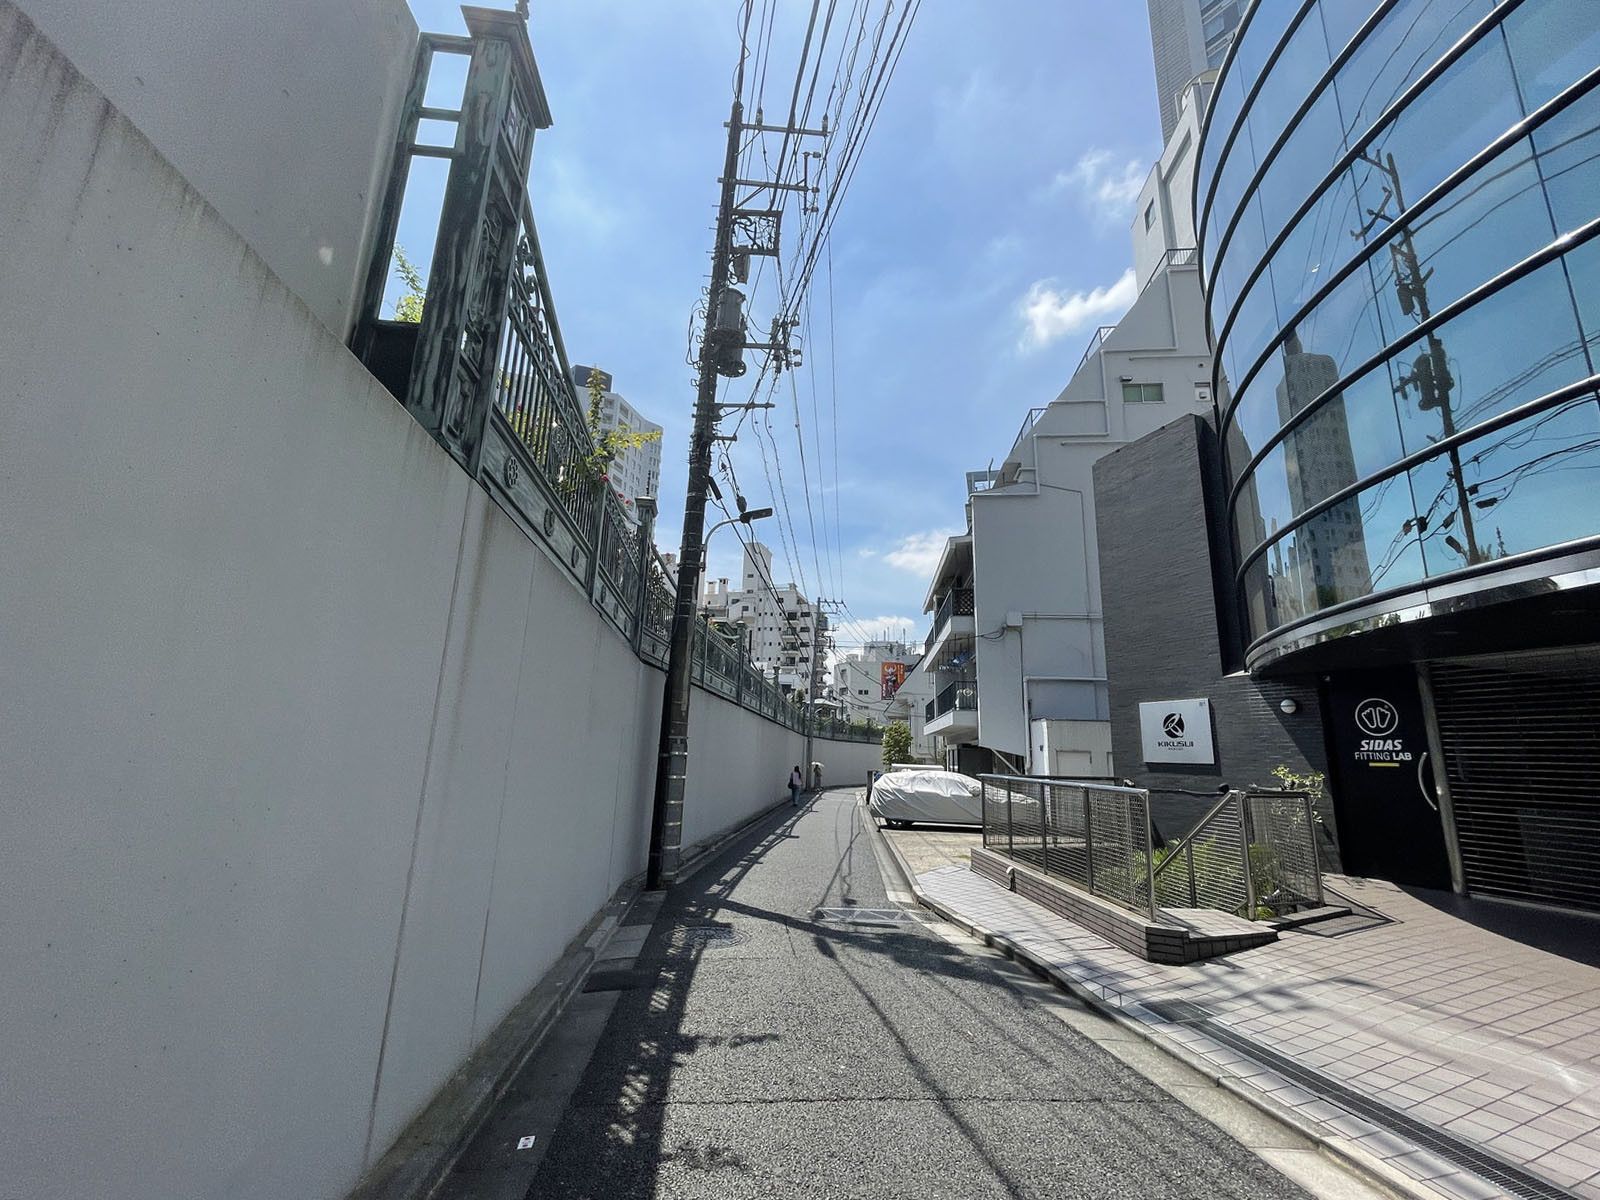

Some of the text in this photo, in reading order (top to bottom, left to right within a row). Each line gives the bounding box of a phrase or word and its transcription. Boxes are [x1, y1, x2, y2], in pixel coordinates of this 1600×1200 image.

[1360, 739, 1402, 751] SIDAS
[1354, 751, 1412, 761] FITTING LAB
